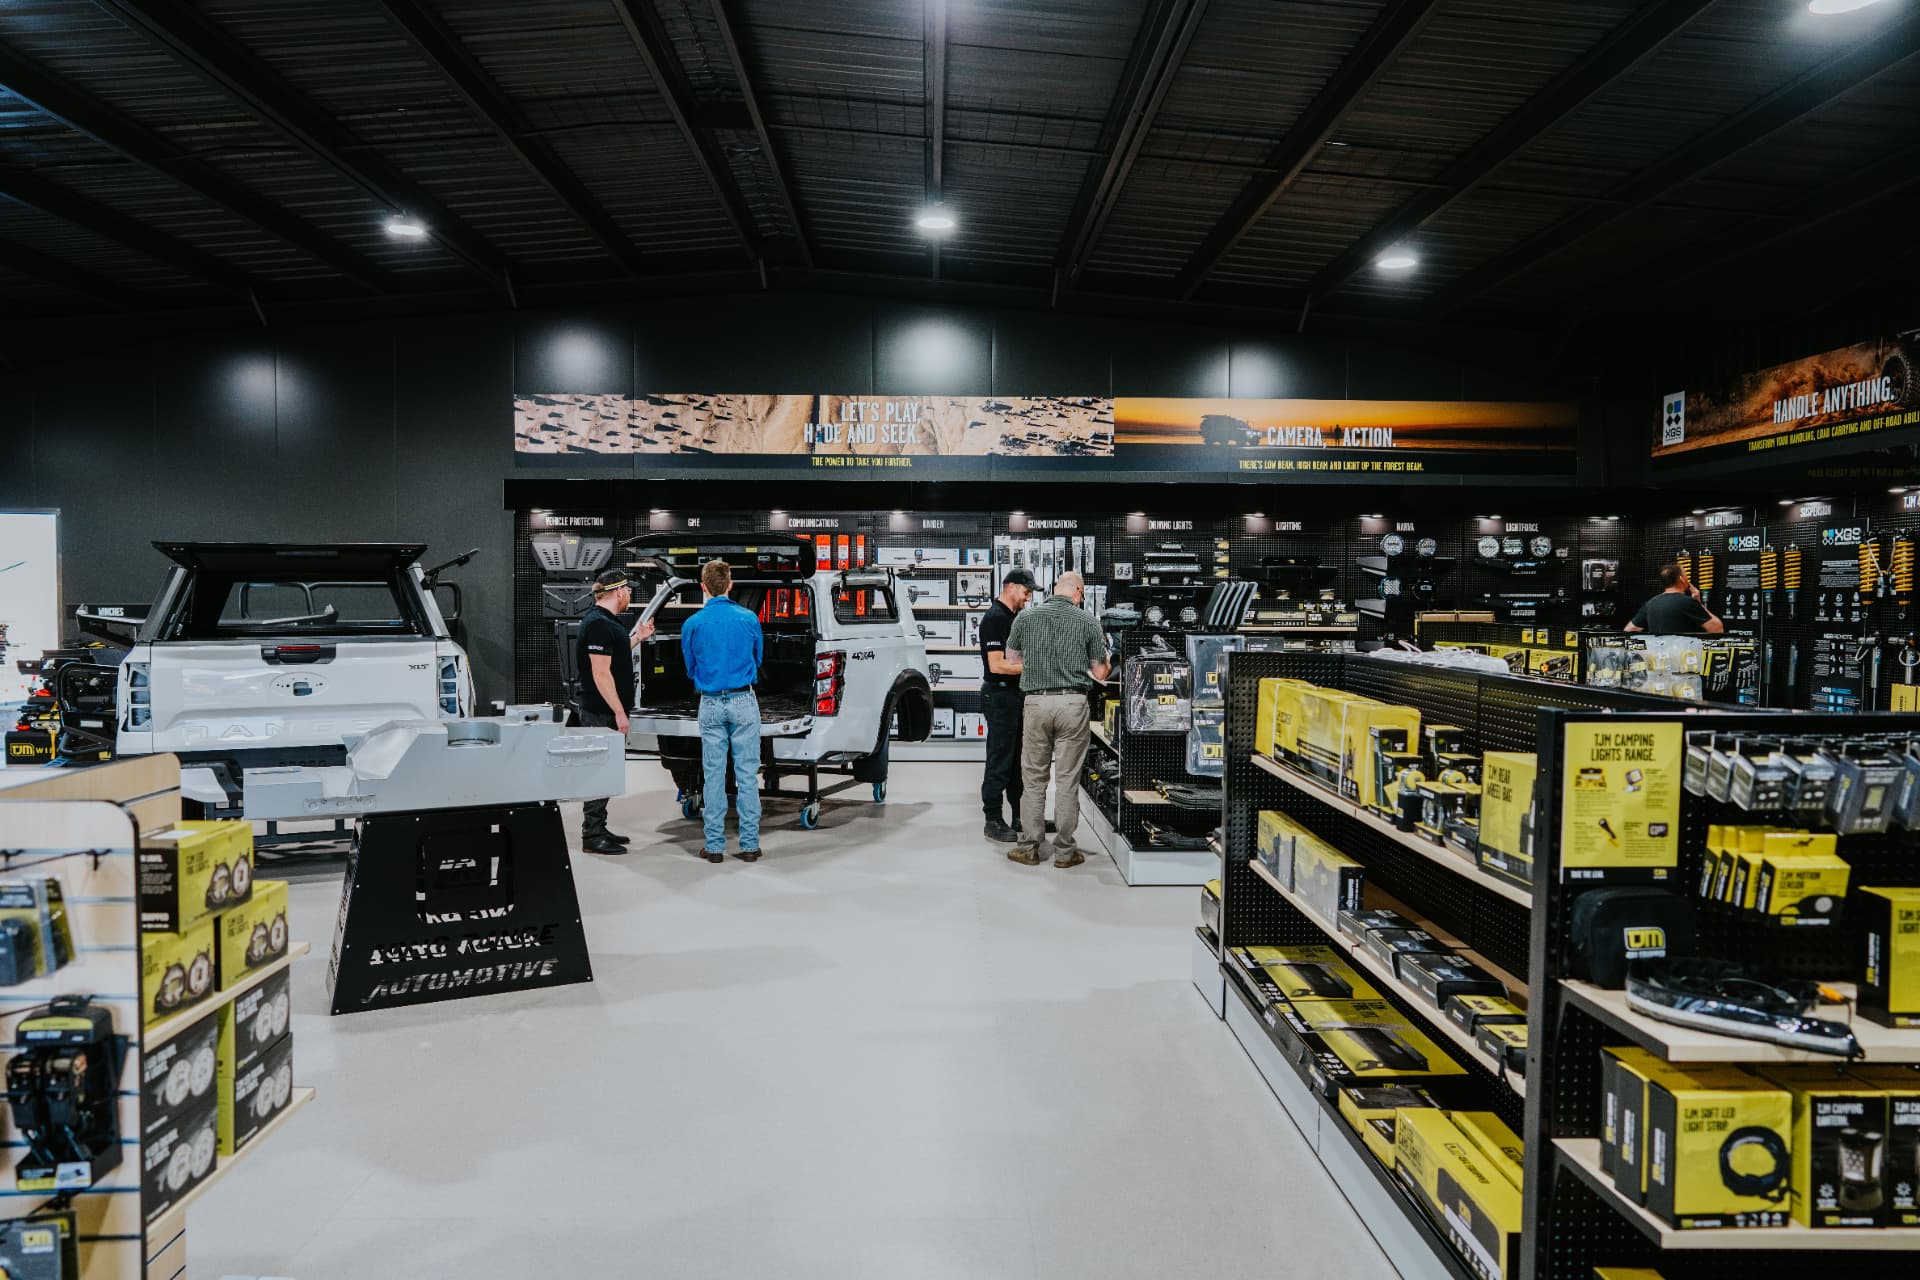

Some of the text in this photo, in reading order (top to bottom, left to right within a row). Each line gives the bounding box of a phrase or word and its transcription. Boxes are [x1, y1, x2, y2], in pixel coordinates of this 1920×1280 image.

[1773, 376, 1895, 424] HANDLE ANYTHING.
[841, 401, 920, 424] LET'S PLAY,
[847, 423, 877, 443] AND
[881, 424, 920, 444] SEEK.
[1267, 426, 1397, 449] CAMERA, ACTION.
[1665, 426, 1682, 438] XGS
[1748, 438, 1775, 452] TRANSFORM
[1776, 435, 1789, 447] YOUR
[1817, 428, 1831, 440] LOAD
[1831, 422, 1858, 438] CARRYING
[1859, 420, 1872, 432] AND
[811, 457, 824, 467] THE
[824, 457, 845, 467] POWER
[846, 457, 854, 467] TO
[855, 457, 870, 467] TAKE
[871, 457, 884, 467] YOU
[1239, 460, 1263, 470] THERE'S
[1264, 460, 1277, 470] LOW
[1296, 460, 1311, 471] HIGH
[1312, 460, 1329, 471] BEAM
[1329, 461, 1342, 471] AND
[1343, 461, 1361, 471] LIGHT
[1361, 461, 1370, 471] UP
[1371, 461, 1383, 471] THE
[1383, 461, 1405, 471] FOREST
[1800, 504, 1832, 518] SUSPENSION
[545, 516, 604, 527] VEHICLE PROTECTION
[687, 518, 701, 527] GME
[788, 518, 840, 528] COMMUNICATIONS
[922, 519, 945, 529] UNIDEN
[1027, 519, 1078, 529] COMMUNICATIONS
[1148, 520, 1193, 530] DRIVING LIGHTS
[1275, 521, 1302, 531] LIGHTING
[1396, 522, 1415, 532] NARVA
[1505, 522, 1539, 532] LIGHTFORCE
[1834, 527, 1862, 541] XGS
[1738, 535, 1760, 548] XGS
[98, 607, 125, 617] WINCHES
[1594, 733, 1655, 746] TJM CAMPING
[11, 744, 35, 756] TJM
[1591, 748, 1657, 762] LIGHTS RANGE.
[1796, 872, 1821, 880] MOTION
[1779, 881, 1805, 890] SENSOR
[1624, 928, 1666, 951] TJM
[360, 957, 560, 1004] AUTOMOTIVE
[1700, 1107, 1720, 1119] SOFT
[1721, 1107, 1736, 1119] LED
[1683, 1121, 1705, 1133] LIGHT
